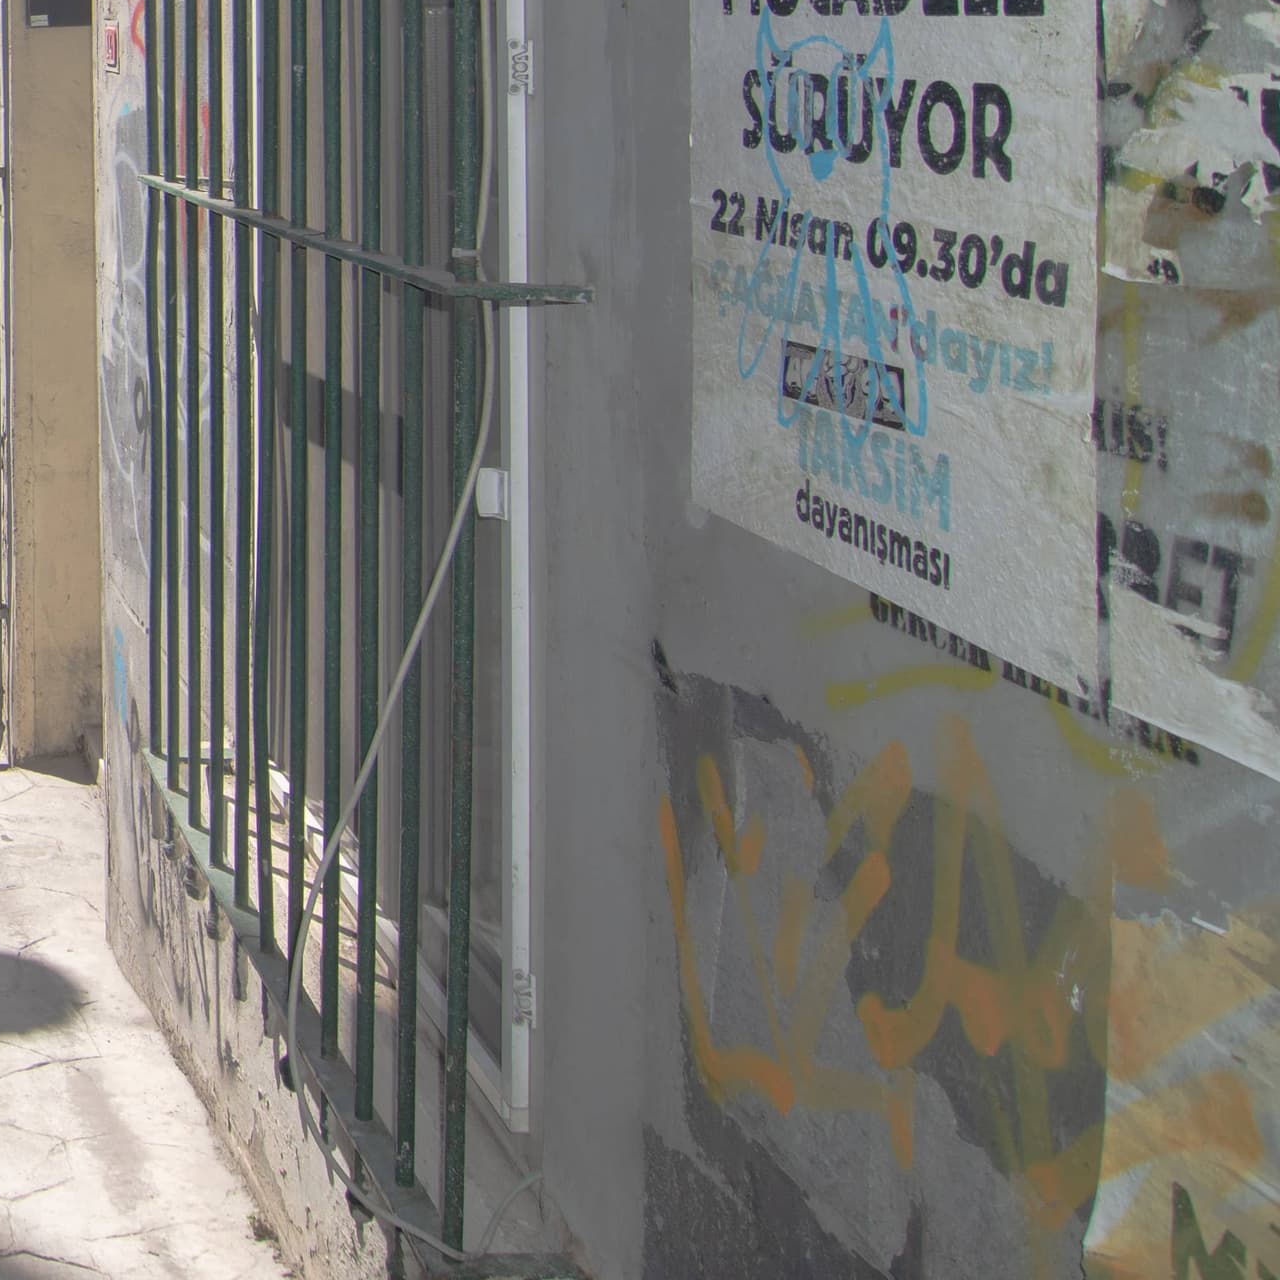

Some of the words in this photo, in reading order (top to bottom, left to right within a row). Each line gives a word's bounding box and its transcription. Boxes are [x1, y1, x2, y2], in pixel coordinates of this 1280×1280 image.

[742, 50, 1013, 183] SÜRÜYOR
[709, 188, 746, 238] 22
[755, 196, 854, 262] Nisan
[799, 406, 951, 533] TAKSİM
[796, 478, 951, 592] dayanışması
